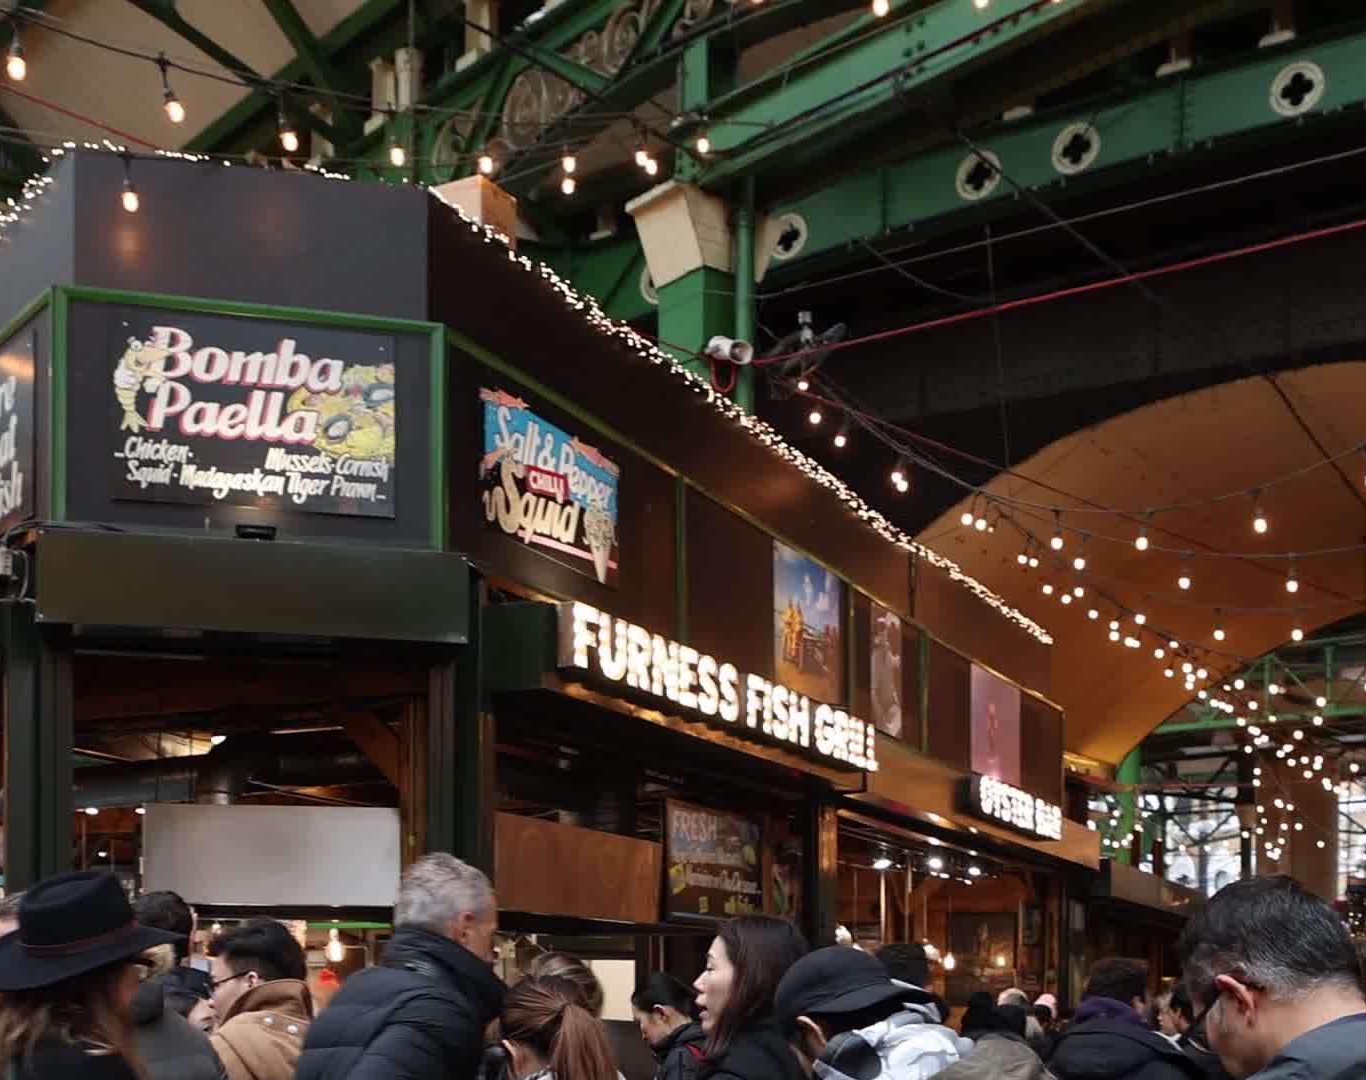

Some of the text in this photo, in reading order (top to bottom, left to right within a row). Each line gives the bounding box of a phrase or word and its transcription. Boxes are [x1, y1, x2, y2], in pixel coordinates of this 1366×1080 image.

[149, 325, 345, 393] Bomba
[146, 380, 319, 445] Paella
[285, 471, 331, 504] Tiger
[494, 406, 614, 508] Salt & Pepper
[483, 453, 581, 545] Squid
[572, 600, 880, 772] FURNESS FISH GRILL
[673, 809, 717, 843] FRESH
